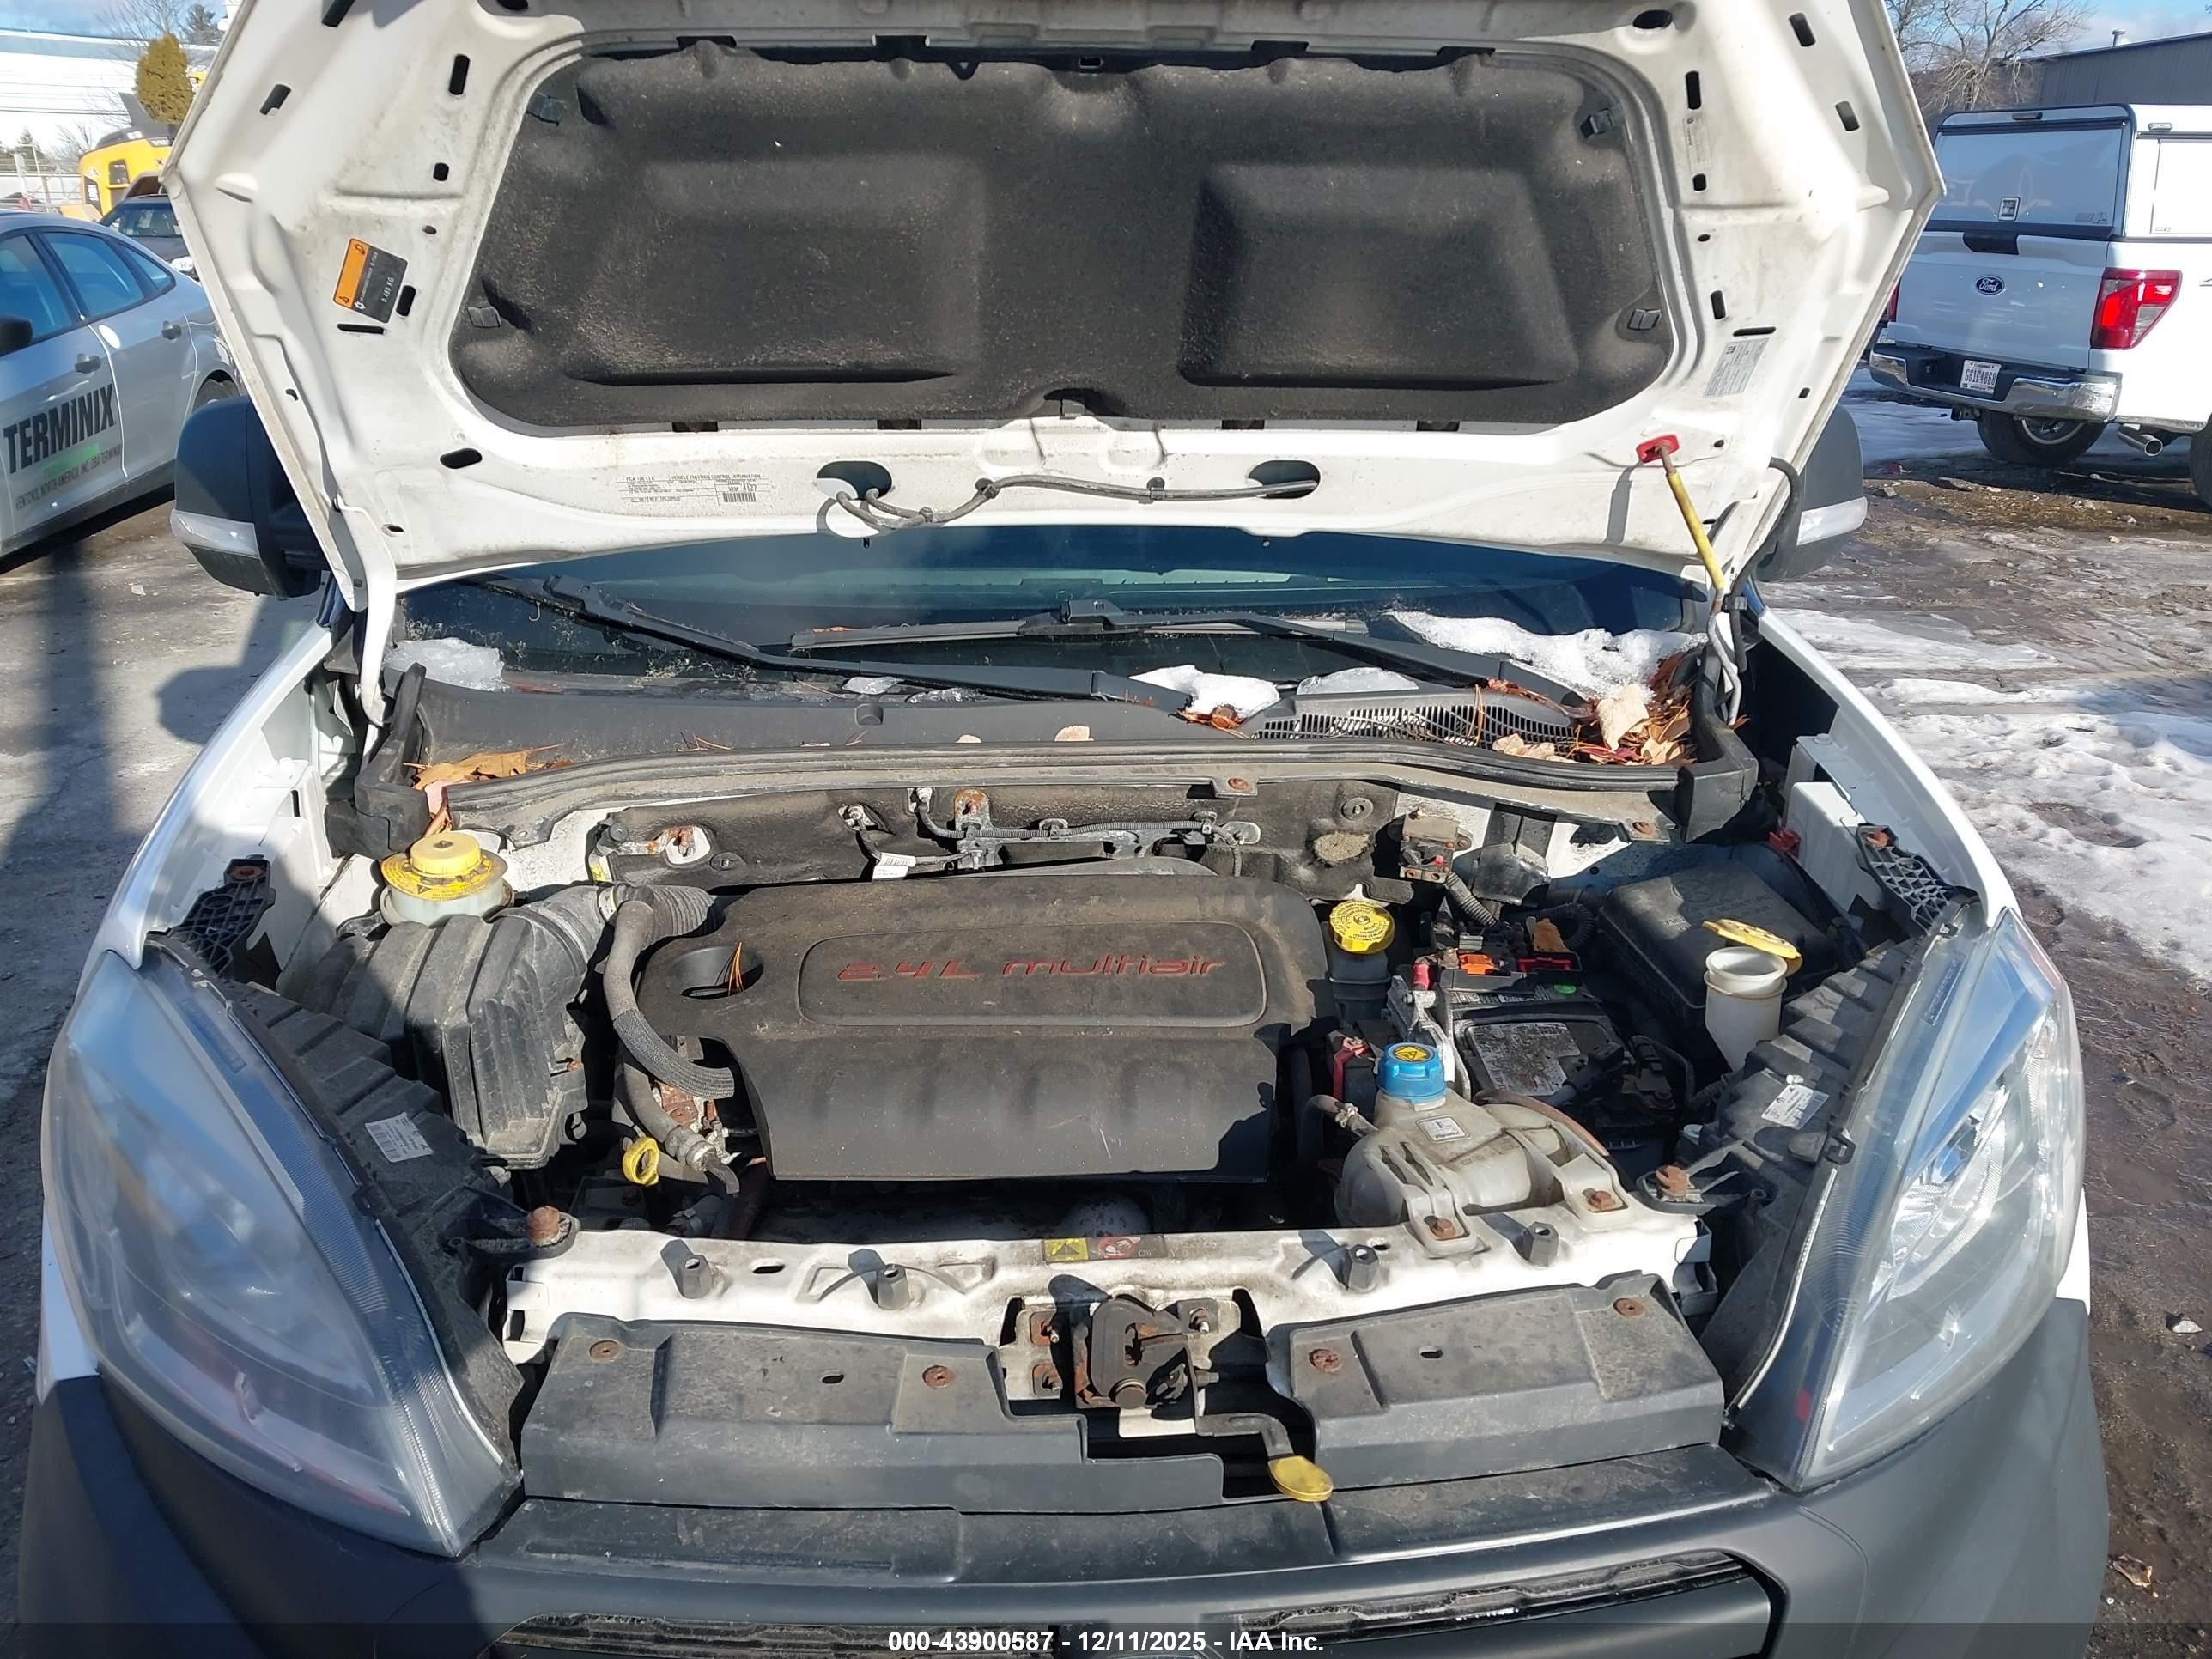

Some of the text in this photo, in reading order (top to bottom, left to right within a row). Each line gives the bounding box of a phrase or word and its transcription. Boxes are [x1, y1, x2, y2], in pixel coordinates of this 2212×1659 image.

[1979, 278, 1999, 292] Ford
[3, 383, 114, 474] TERMINIX
[1002, 954, 1223, 976] multiair
